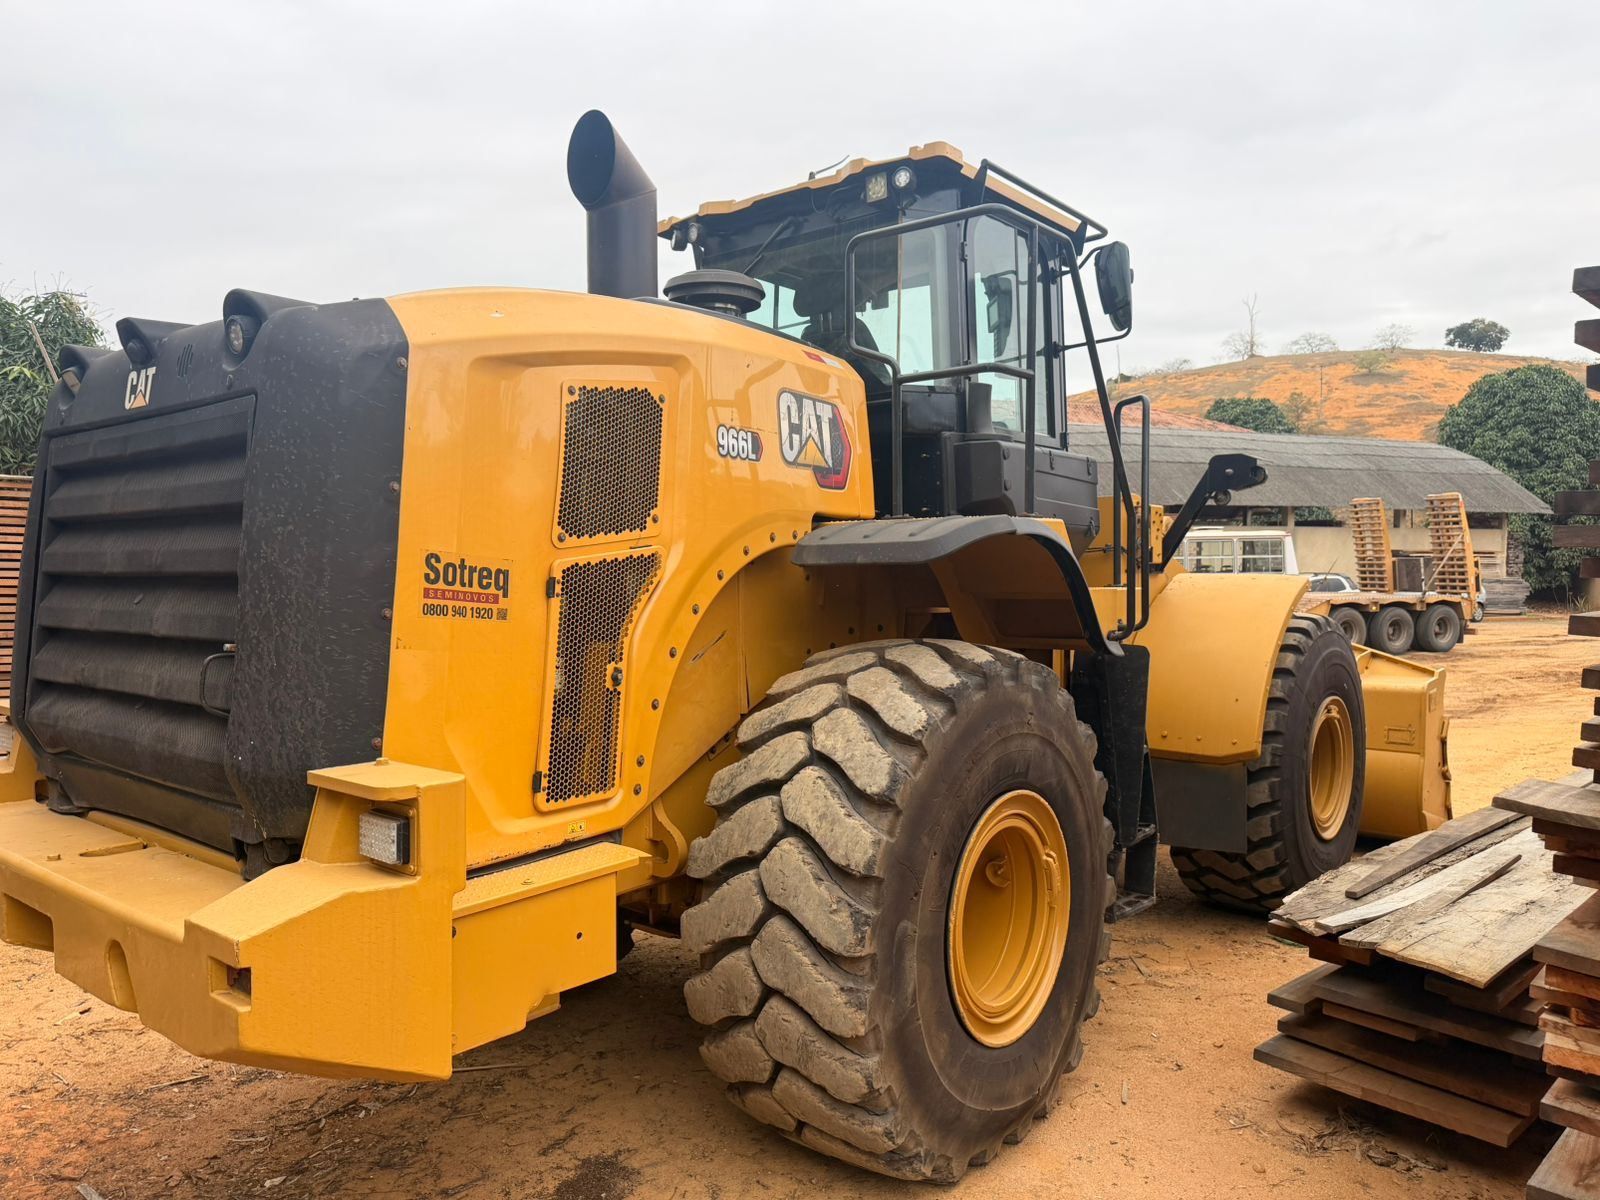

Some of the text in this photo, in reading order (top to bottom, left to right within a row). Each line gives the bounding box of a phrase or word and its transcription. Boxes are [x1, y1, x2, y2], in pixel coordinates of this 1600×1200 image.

[125, 366, 157, 410] CAT
[717, 426, 757, 460] 966L
[779, 392, 833, 468] CAT
[424, 552, 509, 598] Sotreq
[422, 603, 494, 620] 0800 940 1920
[428, 589, 495, 603] SEMINOVOS
